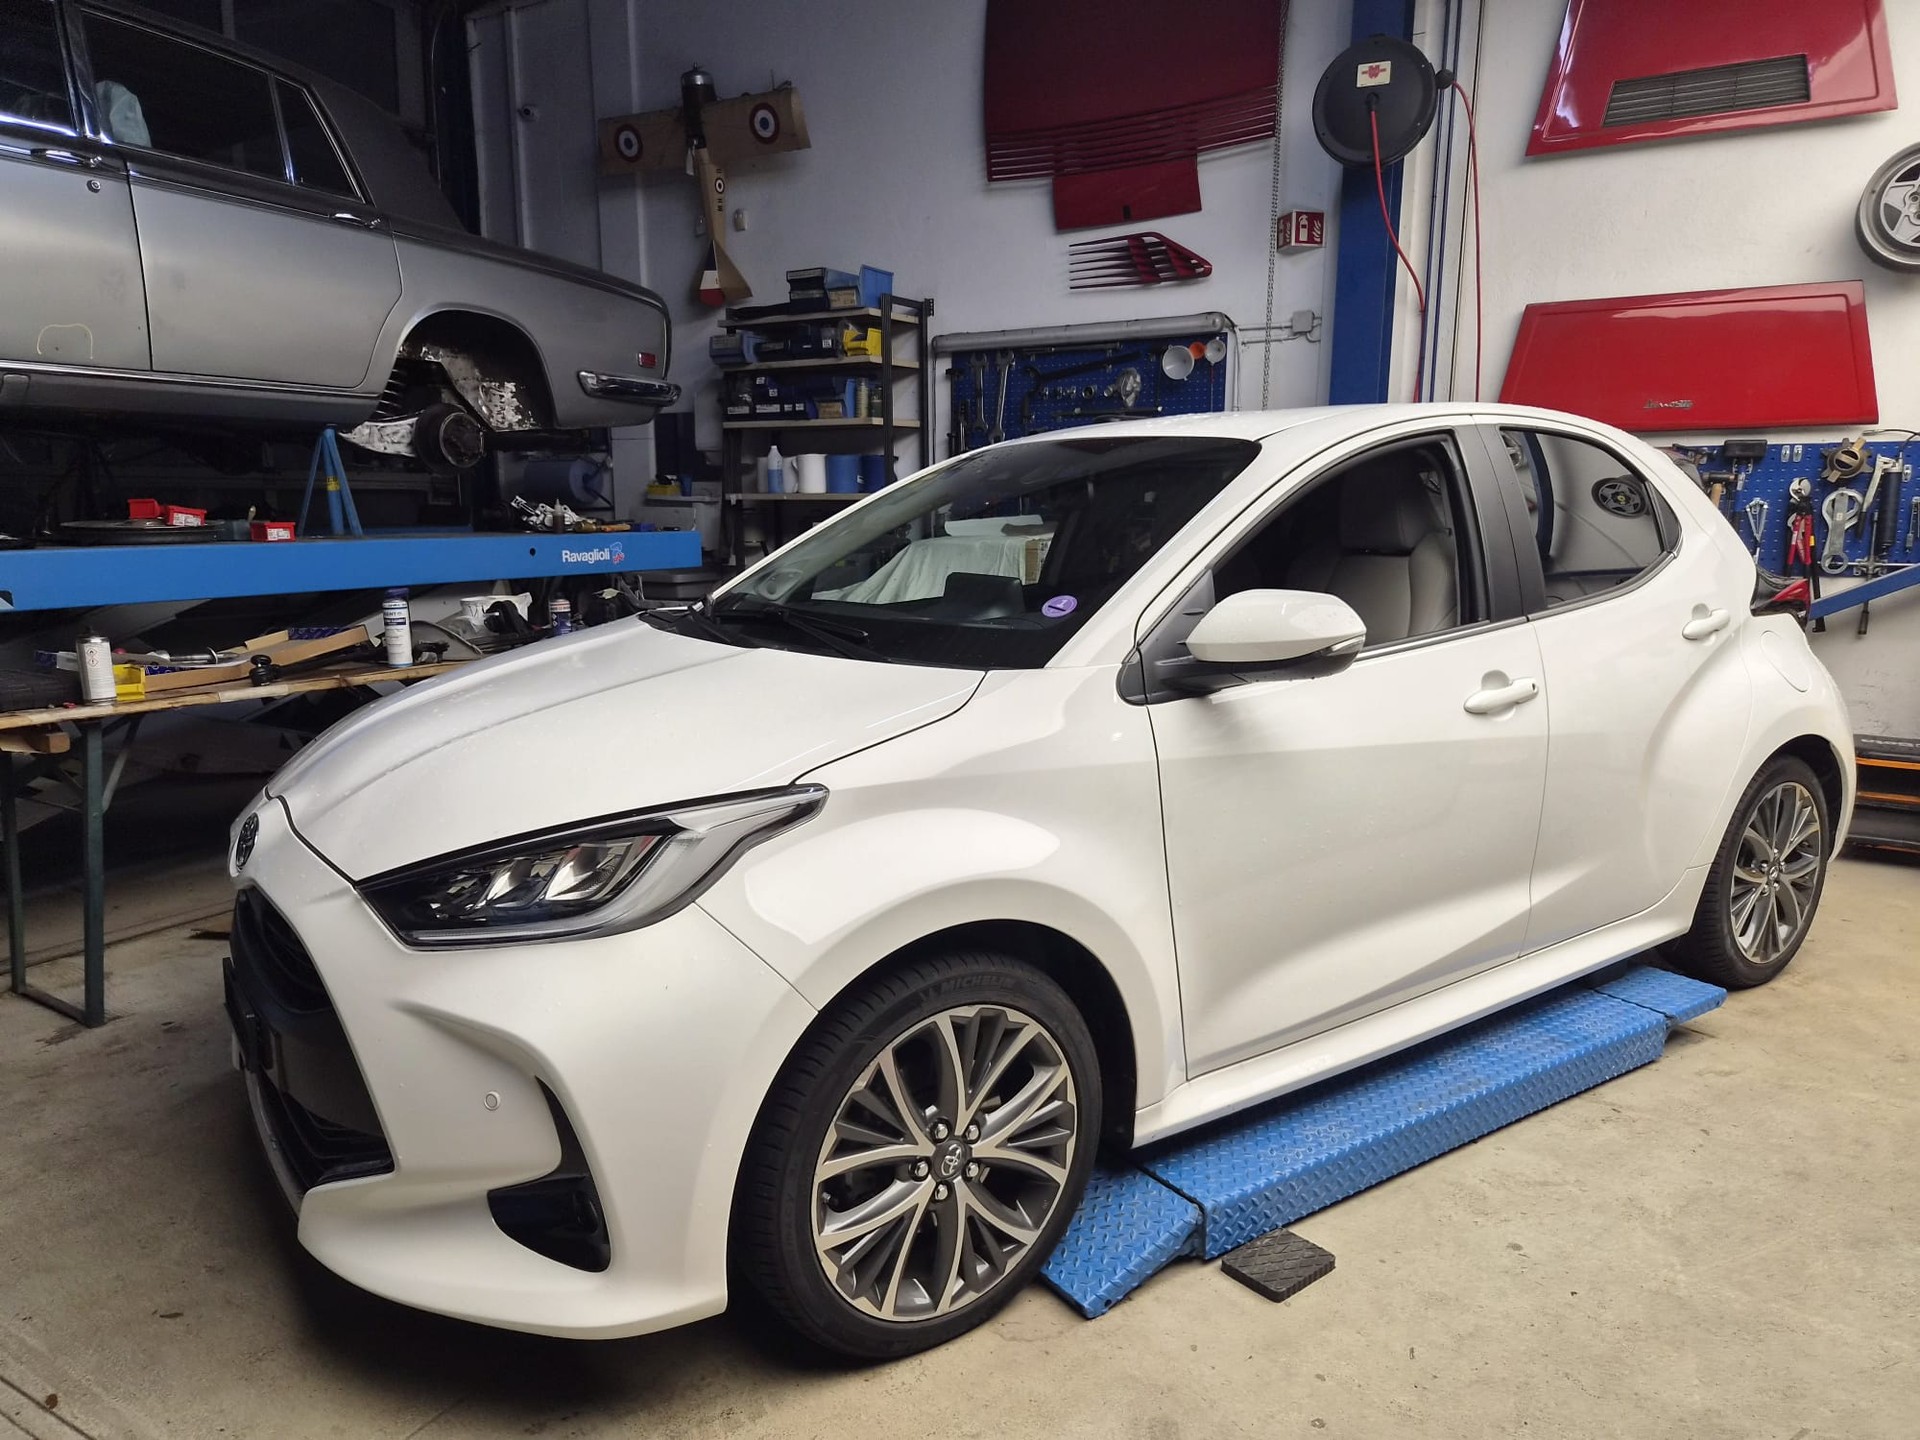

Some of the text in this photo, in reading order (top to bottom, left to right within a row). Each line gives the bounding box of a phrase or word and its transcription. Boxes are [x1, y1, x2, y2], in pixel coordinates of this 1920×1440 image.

[562, 548, 610, 564] Ravaglioli
[1056, 599, 1068, 608] 1
[940, 974, 1014, 992] MICHELIN
